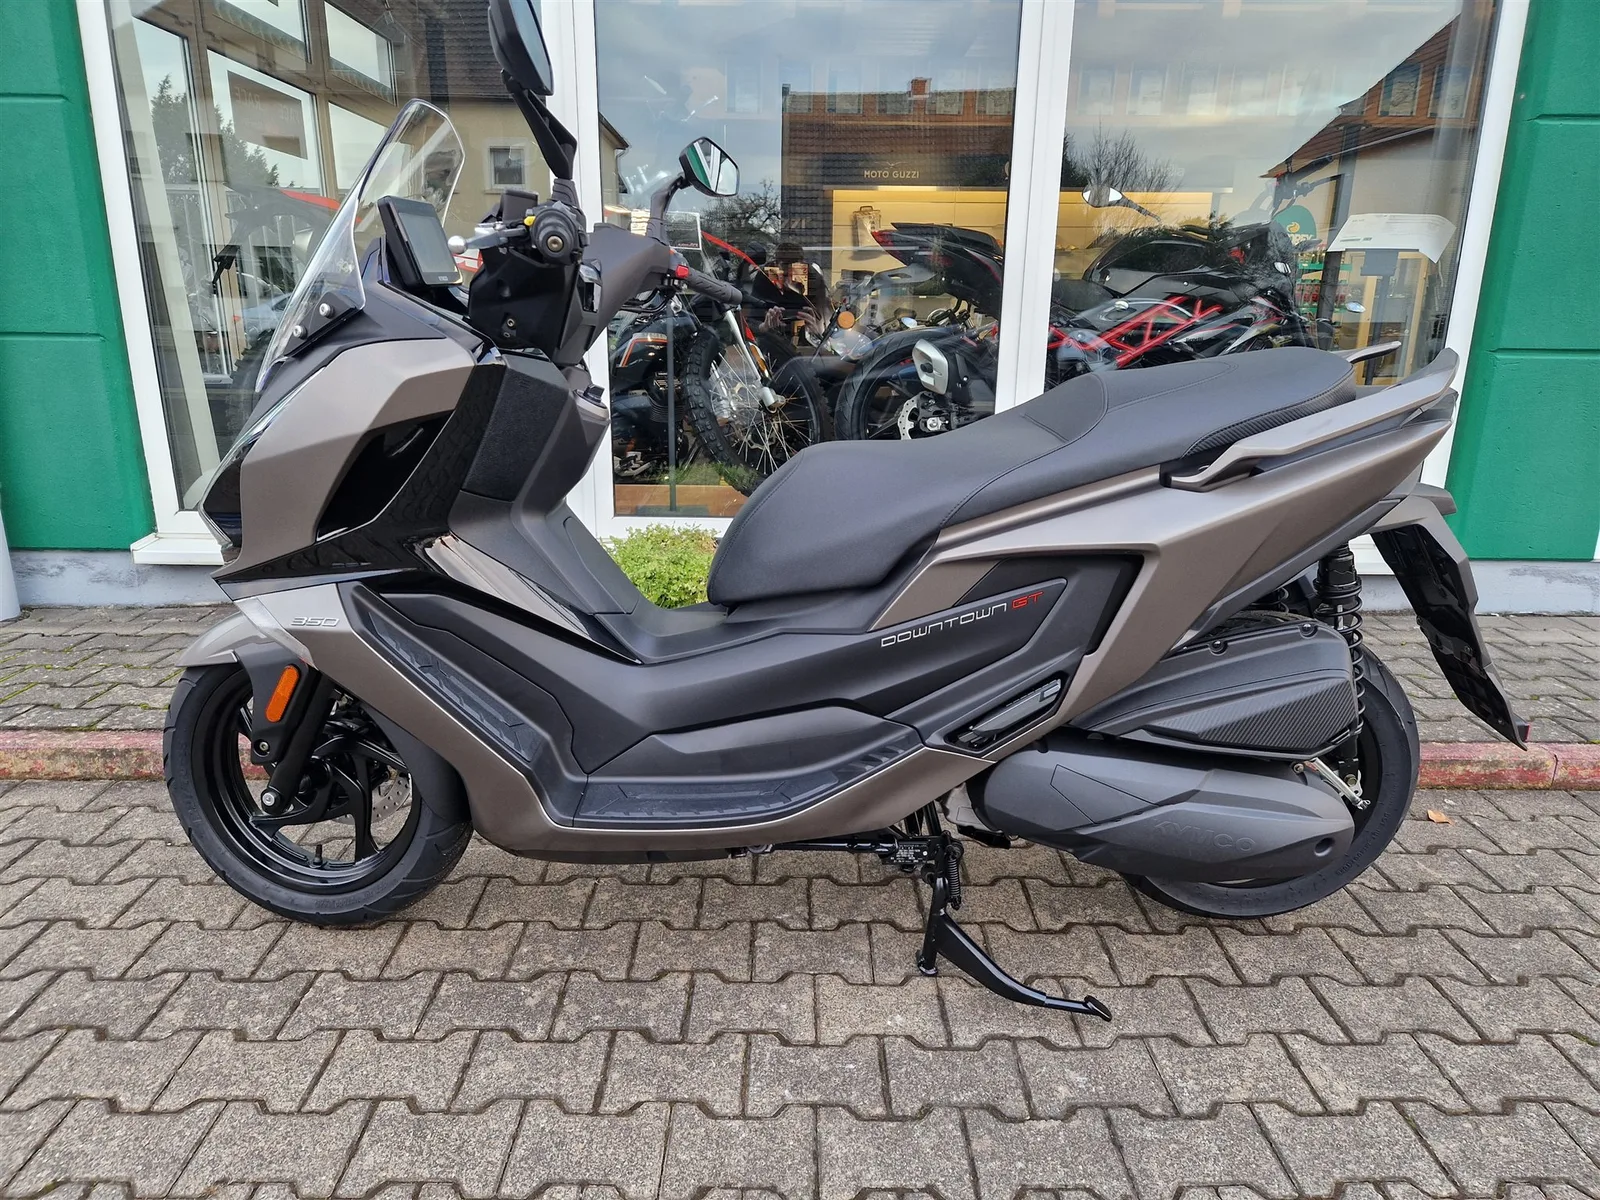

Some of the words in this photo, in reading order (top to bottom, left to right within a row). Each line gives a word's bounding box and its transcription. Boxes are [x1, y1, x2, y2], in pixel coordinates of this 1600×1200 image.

[864, 170, 889, 178] MOTO
[892, 170, 919, 178] GUZZI
[291, 616, 340, 627] 350
[881, 602, 1007, 648] DOWNTOWN
[1012, 591, 1044, 610] GT
